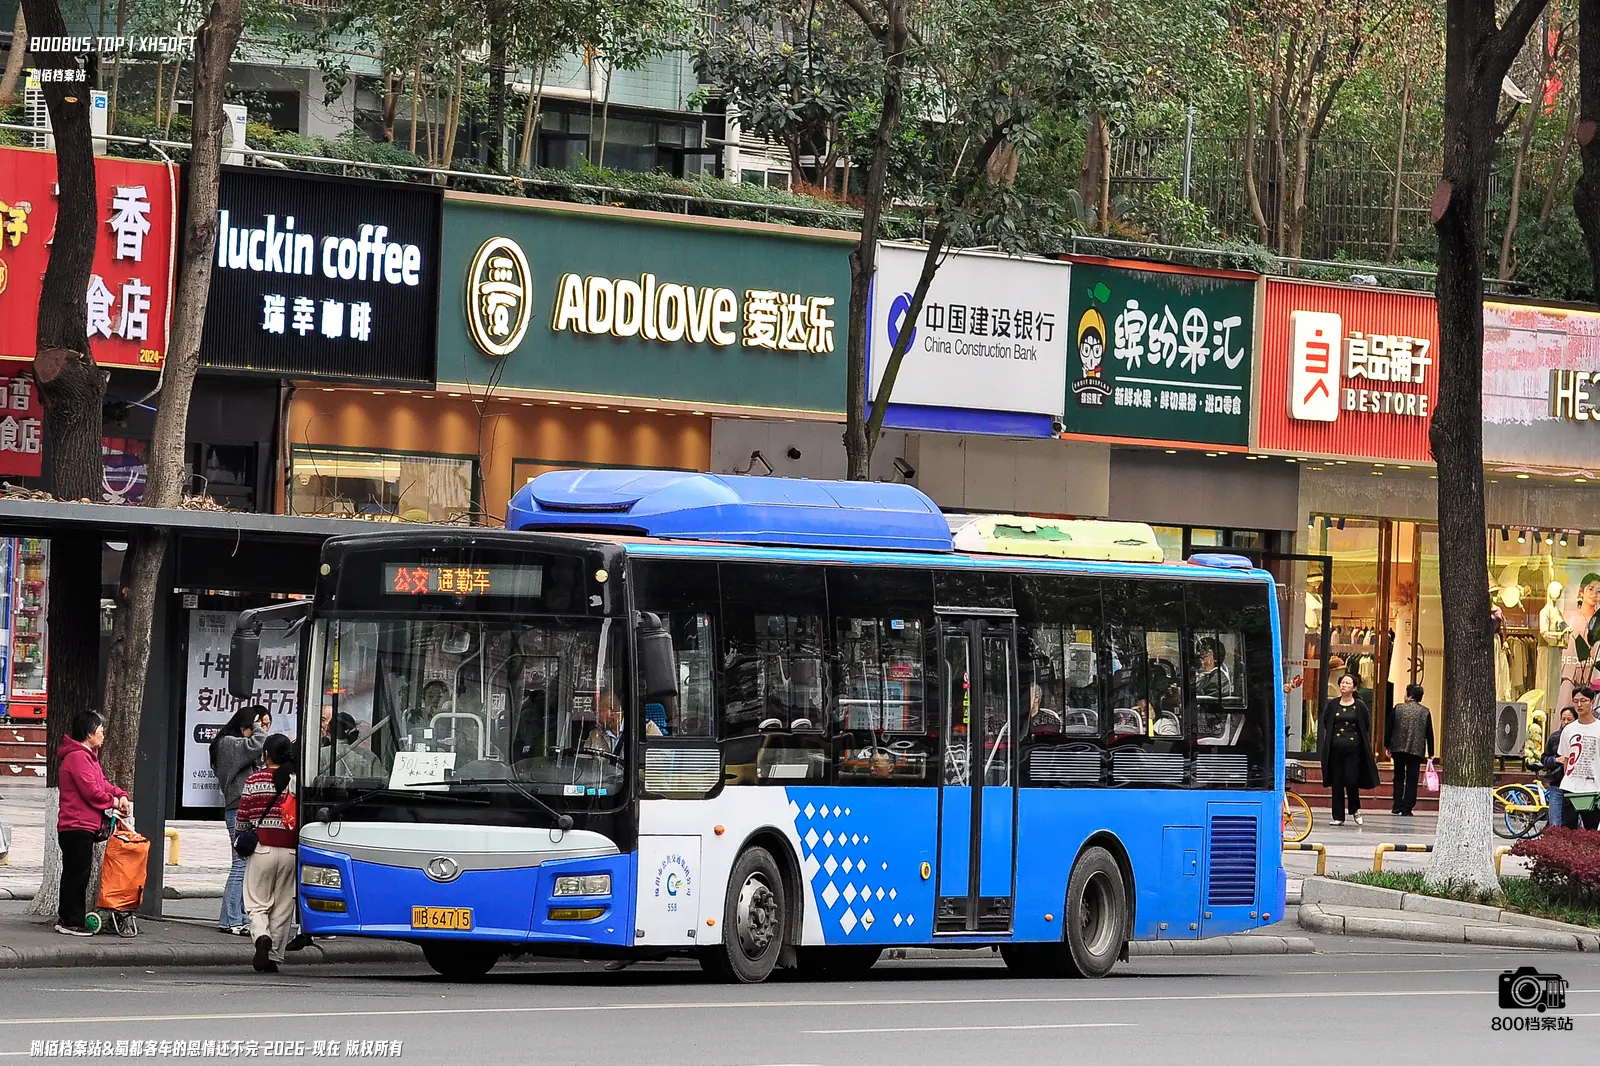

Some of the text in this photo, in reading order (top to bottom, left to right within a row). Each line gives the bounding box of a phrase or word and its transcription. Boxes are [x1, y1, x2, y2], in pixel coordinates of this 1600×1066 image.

[218, 209, 421, 287] luckin coffee
[262, 294, 372, 342] 瑞幸咖啡
[742, 288, 835, 353] 爱达乐
[925, 303, 1055, 343] 中国建设银行
[1114, 299, 1245, 375] 缤纷果汇
[924, 336, 1037, 361] China Construction Bank
[1345, 331, 1433, 384] 良品铺子
[1345, 388, 1428, 417] BESTORE
[394, 567, 491, 595] 公交 通勤车
